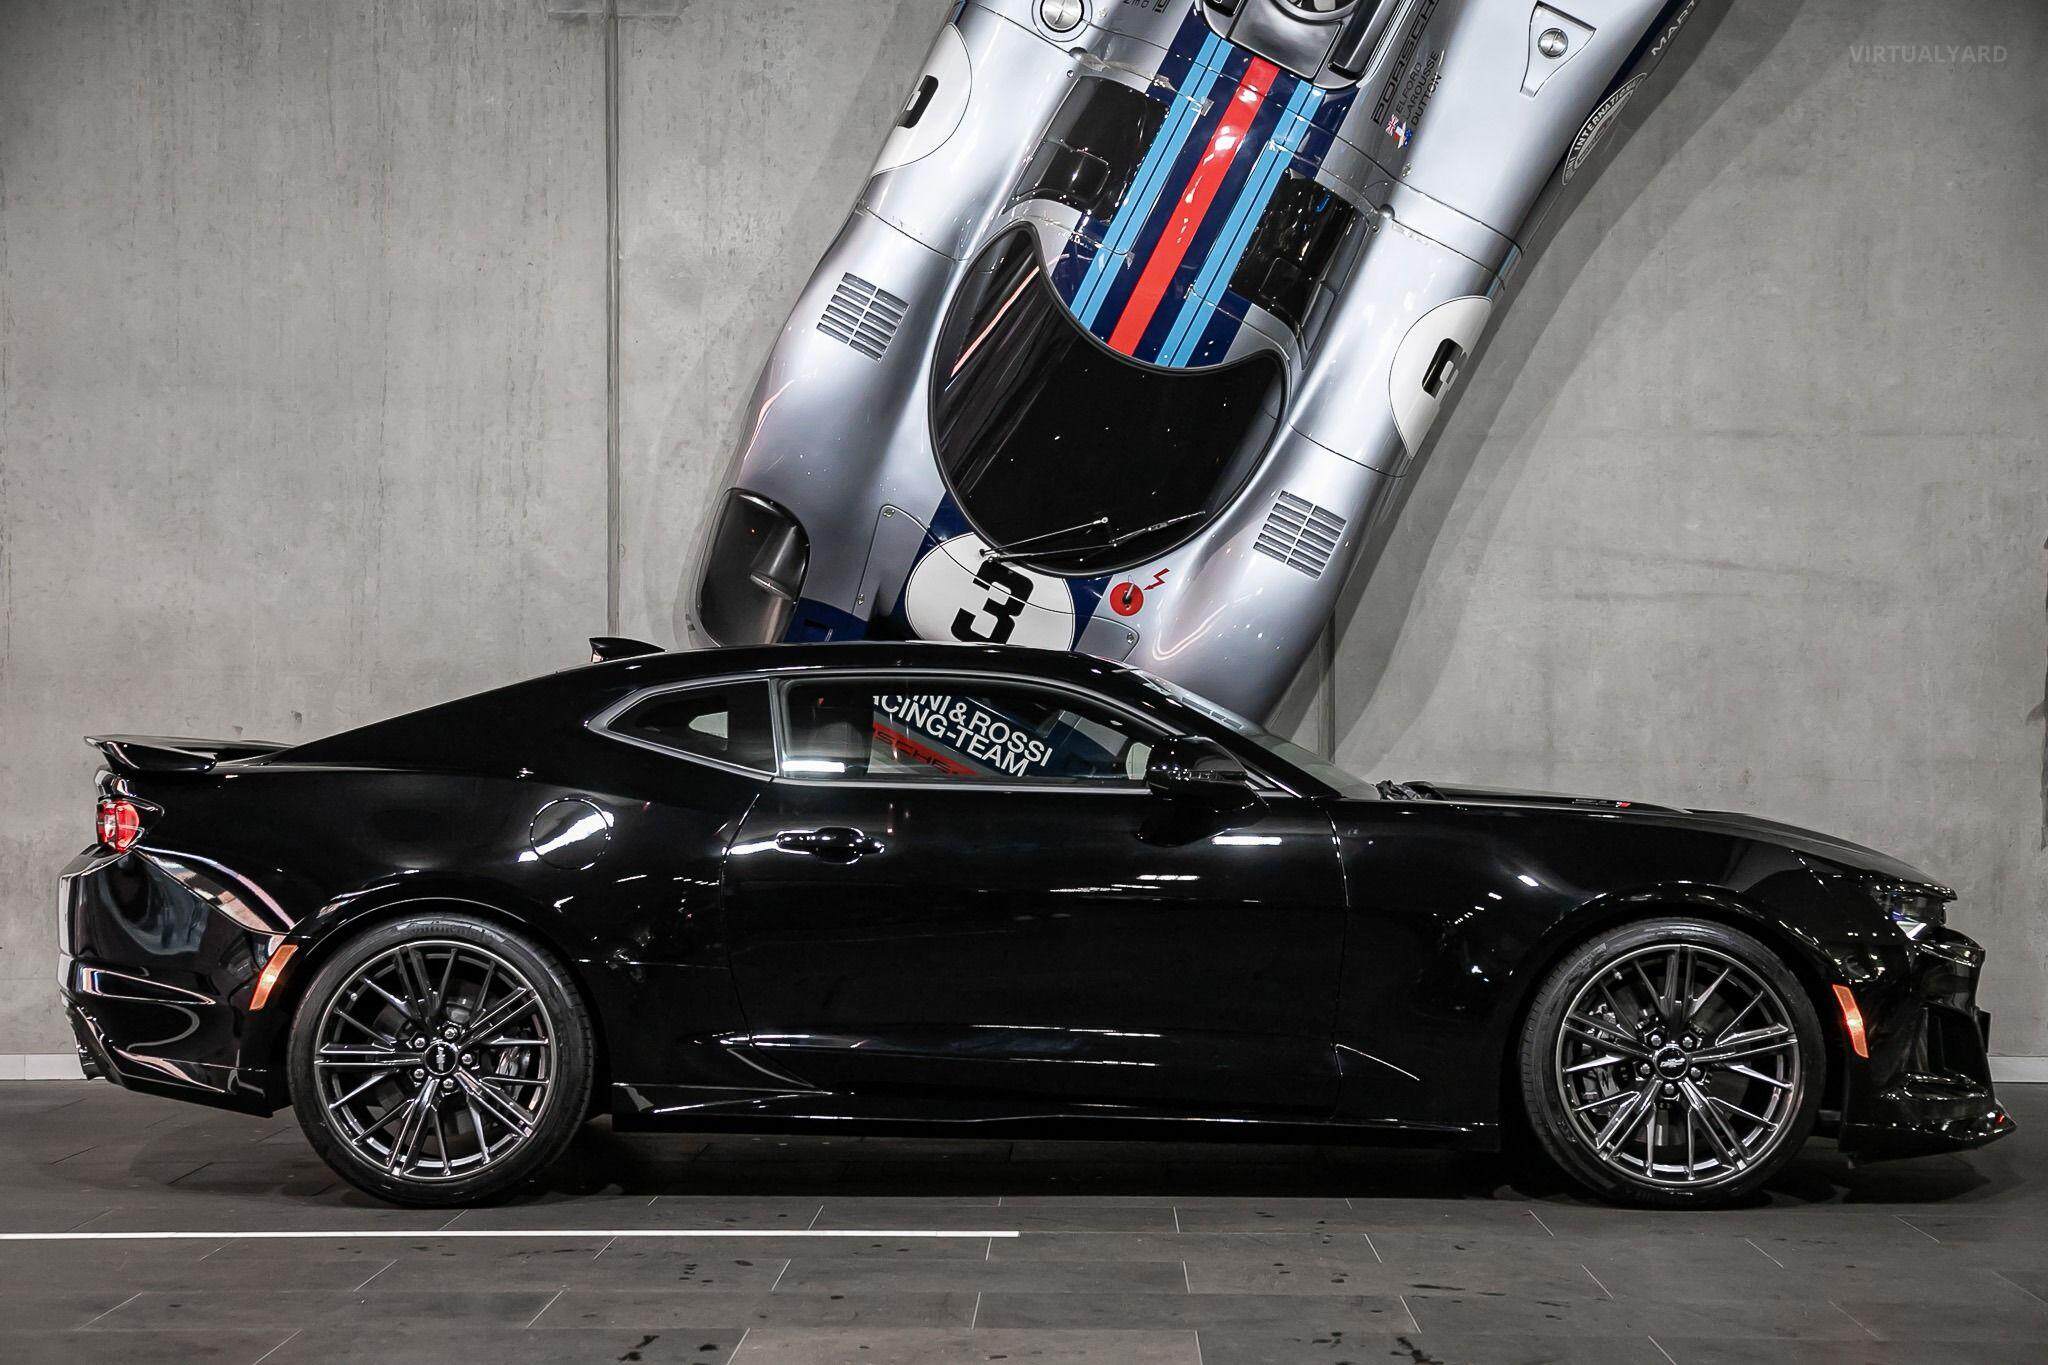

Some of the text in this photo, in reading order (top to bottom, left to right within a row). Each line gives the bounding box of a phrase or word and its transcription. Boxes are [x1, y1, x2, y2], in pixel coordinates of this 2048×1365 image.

[1395, 62, 1423, 115] ELFORD
[1411, 73, 1442, 126] DUTTON
[951, 556, 1034, 645] 3
[913, 696, 1053, 767] NI & ROSSI
